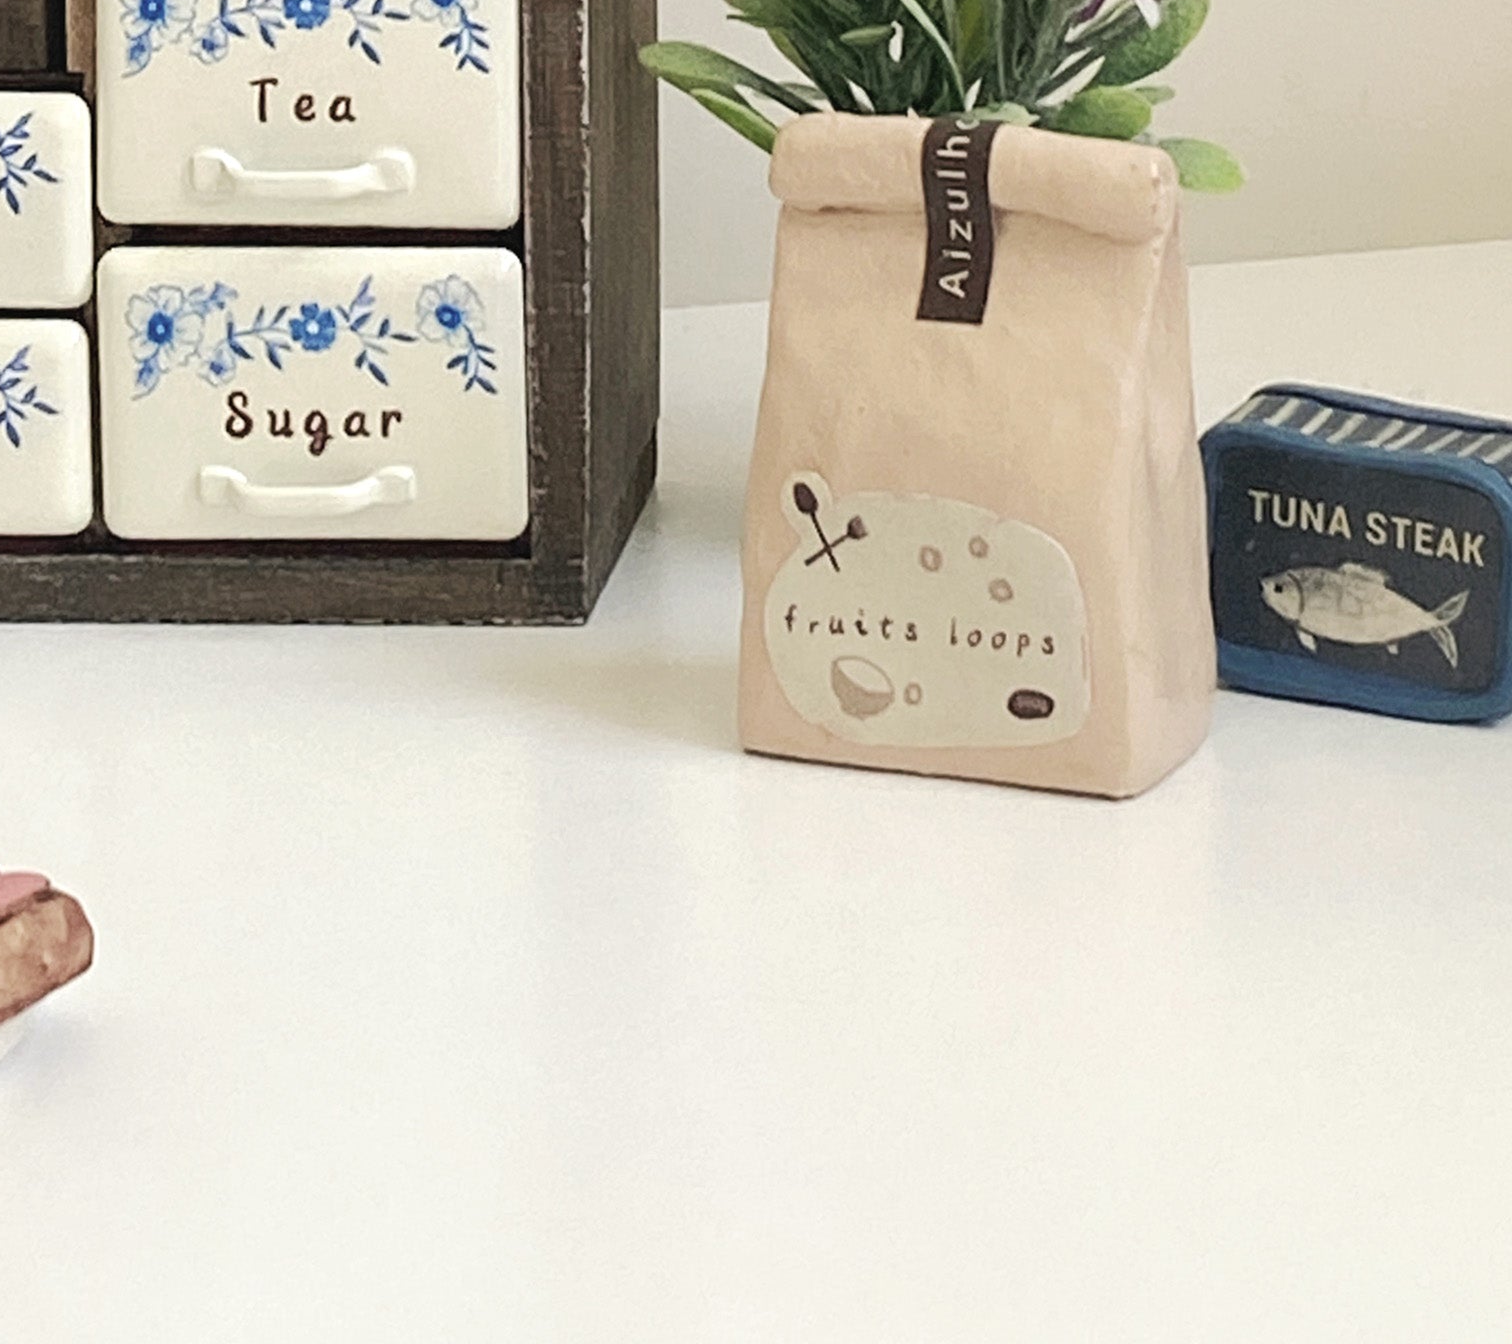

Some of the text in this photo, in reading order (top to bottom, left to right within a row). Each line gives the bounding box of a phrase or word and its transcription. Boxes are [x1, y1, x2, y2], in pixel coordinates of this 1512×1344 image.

[248, 76, 358, 125] Tea
[224, 389, 405, 457] Sugar
[1247, 488, 1485, 567] TUNA STEAK
[785, 603, 1055, 658] fruits loops
